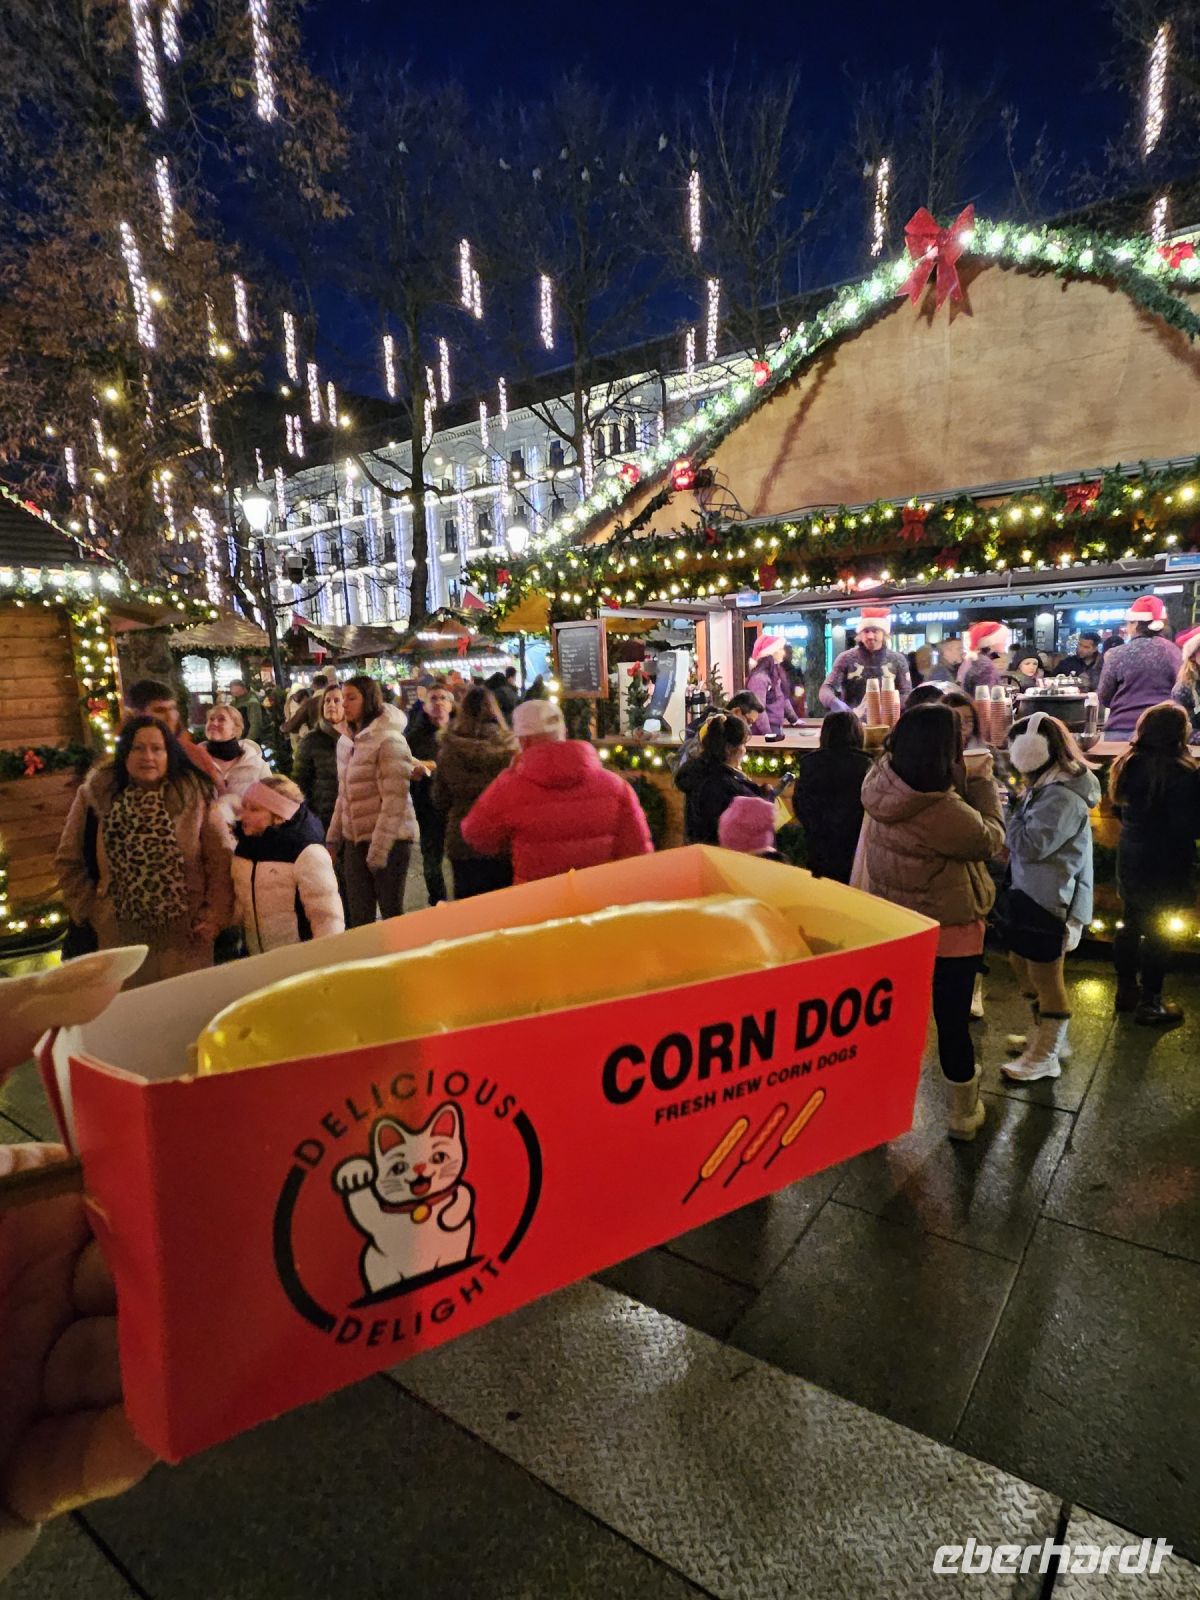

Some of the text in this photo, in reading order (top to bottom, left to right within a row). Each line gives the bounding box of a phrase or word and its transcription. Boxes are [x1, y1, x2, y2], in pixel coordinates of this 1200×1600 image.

[602, 977, 894, 1106] CORN DOG
[655, 1044, 858, 1126] FRESH NEW CORN DOGS
[293, 1070, 517, 1169] DELICIOUS
[336, 1260, 503, 1348] DELIGHT
